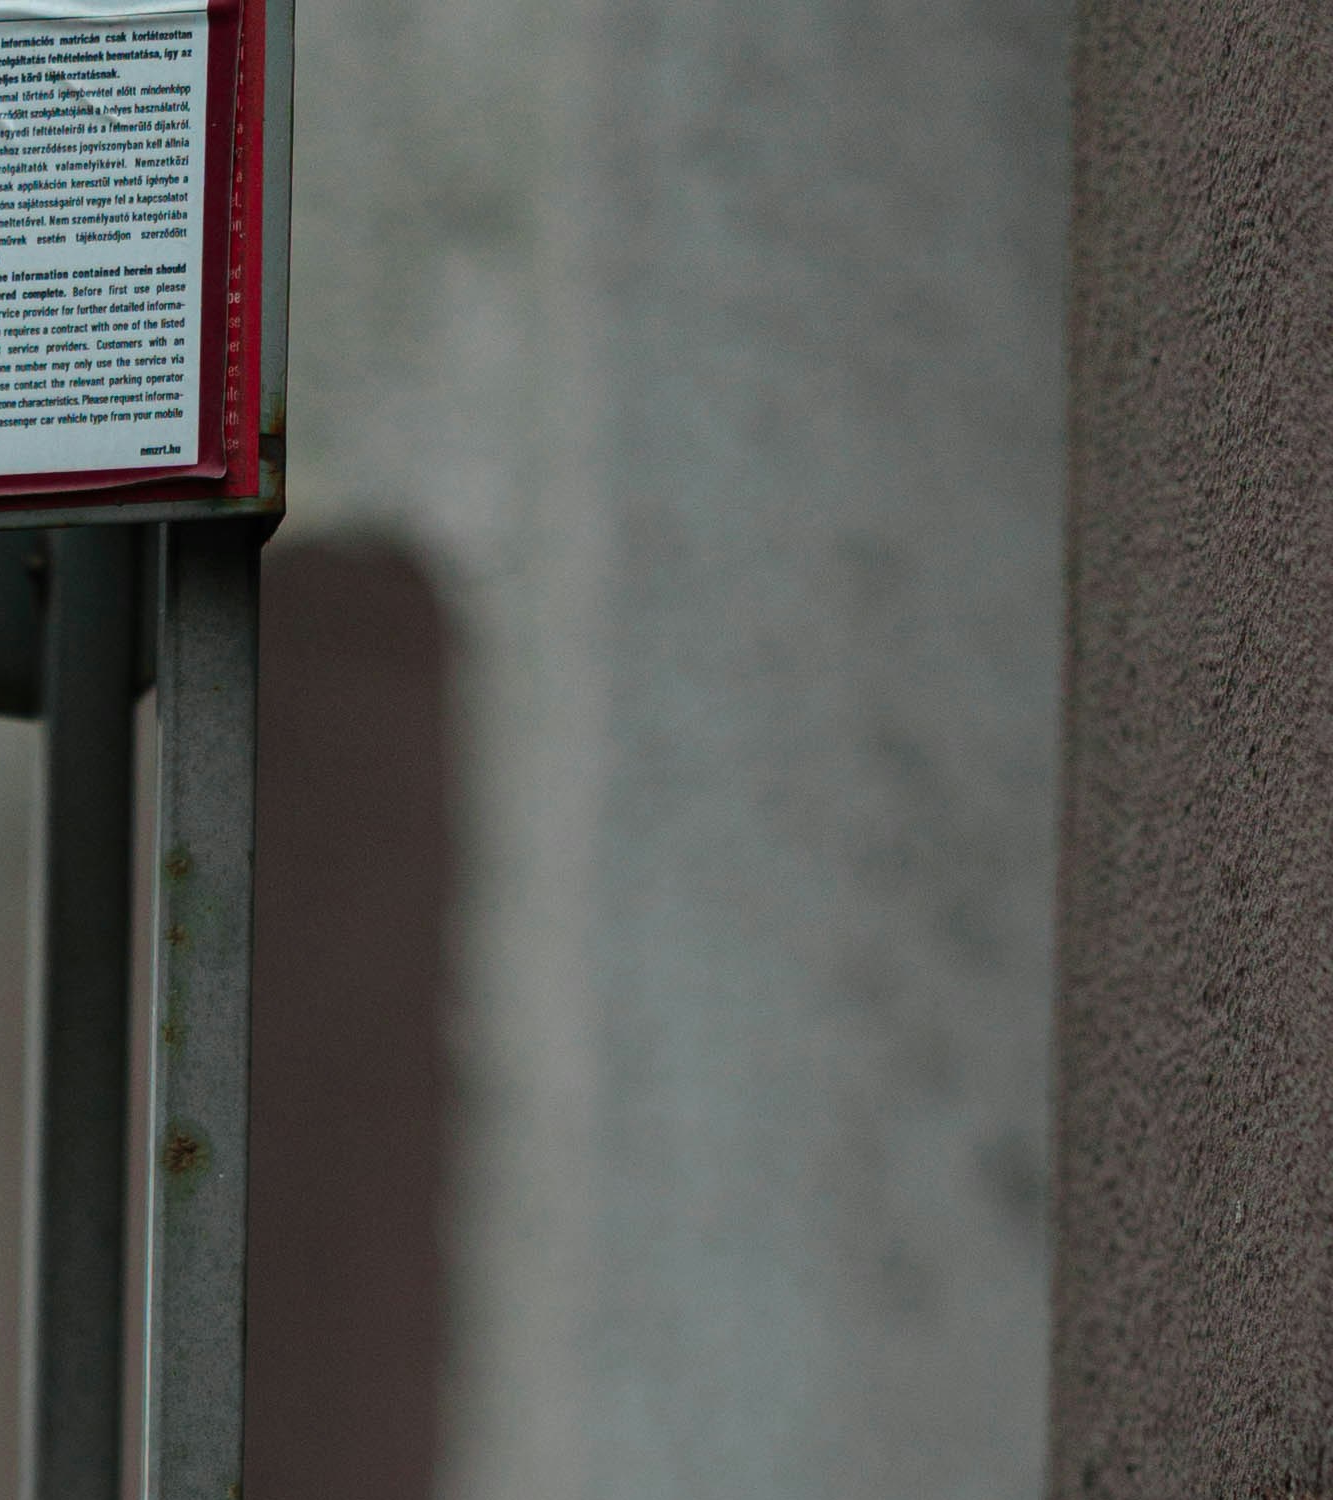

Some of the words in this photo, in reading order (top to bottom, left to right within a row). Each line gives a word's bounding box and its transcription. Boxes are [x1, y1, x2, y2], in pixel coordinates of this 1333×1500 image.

[11, 269, 68, 281] information
[72, 266, 120, 278] contained
[124, 265, 153, 276] herein
[156, 263, 186, 274] should
[22, 288, 66, 300] complete.
[73, 286, 102, 297] Before
[109, 285, 127, 294] first
[134, 285, 149, 293] use
[156, 282, 185, 294] please
[22, 306, 59, 319] provider
[61, 305, 74, 315] for
[77, 304, 107, 314] further
[109, 301, 145, 313] detailed
[146, 300, 185, 311] informa-
[3, 325, 40, 338] requires
[51, 323, 87, 334] contract
[91, 321, 109, 332] with
[112, 322, 129, 331] one
[131, 319, 140, 330] of
[143, 319, 158, 329] the
[161, 317, 185, 328] listed
[8, 343, 39, 354] service
[46, 341, 89, 354] providers.
[96, 339, 142, 350] Customers
[149, 336, 167, 347] with
[173, 337, 184, 346] an
